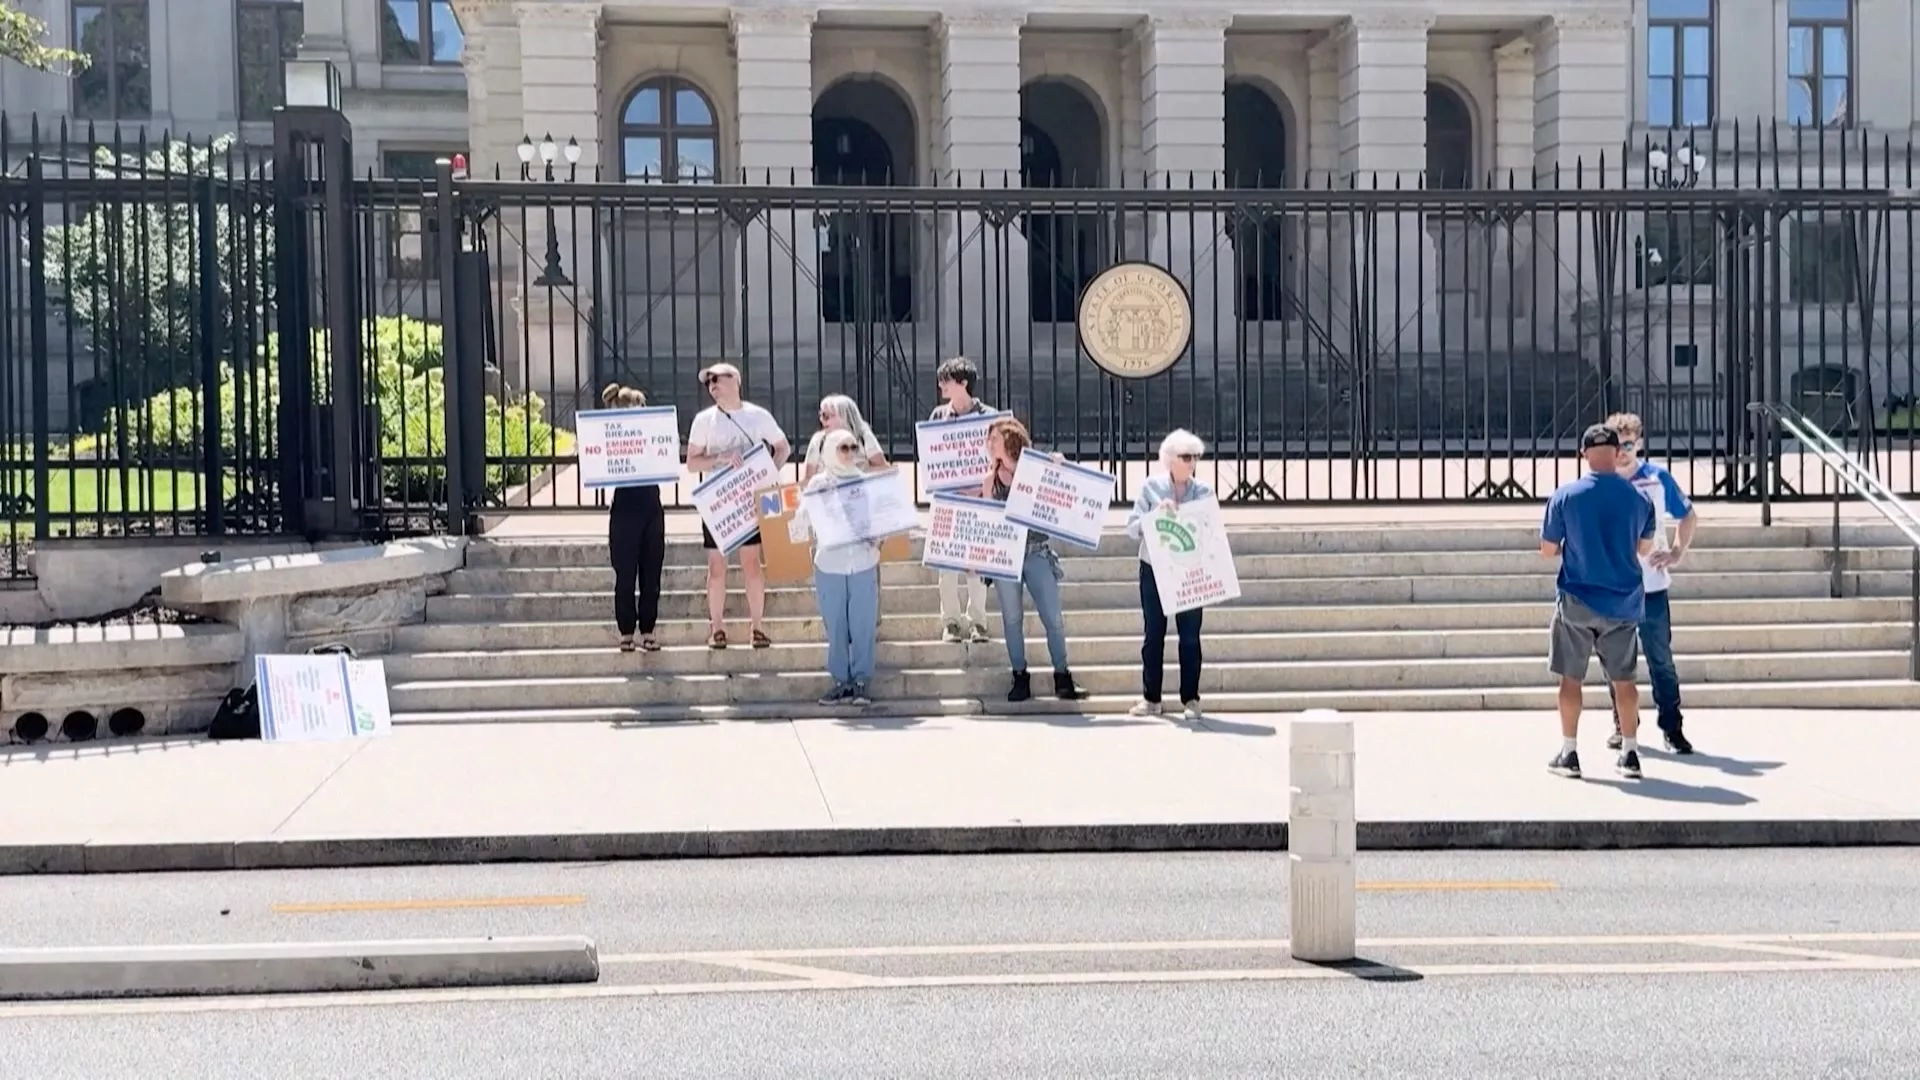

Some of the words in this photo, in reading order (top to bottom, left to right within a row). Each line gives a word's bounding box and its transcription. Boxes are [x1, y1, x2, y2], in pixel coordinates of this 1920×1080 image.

[604, 422, 622, 431] TAX
[605, 429, 643, 439] BREAKS
[585, 445, 602, 456] NO
[606, 438, 648, 449] EMINENT
[651, 435, 672, 445] FOR
[606, 447, 644, 457] DOMAIN
[657, 447, 668, 457] AI
[930, 442, 966, 454] NEVER
[957, 449, 979, 458] FOR
[607, 458, 631, 467] RATE
[608, 465, 637, 475] HIKES
[930, 469, 958, 480] DATA
[1043, 467, 1061, 478] TAX
[709, 489, 739, 513] NEVER
[740, 468, 768, 491] VOTED
[715, 467, 755, 498] GEORGIA
[1040, 476, 1078, 493] BREAKS
[734, 491, 753, 506] FOR
[1016, 483, 1033, 494] NO
[1037, 485, 1079, 504] EMINENT
[1082, 496, 1103, 510] FOR
[935, 507, 954, 515] OUR
[956, 510, 978, 520] DATA
[1033, 502, 1057, 515] RATE
[1036, 493, 1074, 509] DOMAIN
[1083, 511, 1095, 521] AI
[714, 499, 756, 532] HYPERSC
[934, 514, 953, 522] OUR
[955, 518, 972, 526] TAX
[974, 520, 1014, 532] DOLLARS
[1031, 510, 1060, 525] HIKES
[720, 520, 742, 539] DATA
[932, 529, 951, 538] OUR
[953, 532, 996, 545] UTILITIES
[933, 522, 952, 530] OUR
[954, 525, 985, 537] SEIZED
[987, 529, 1018, 541] HOMES
[930, 540, 945, 549] ALL
[948, 543, 967, 551] FOR
[969, 546, 996, 556] THEIR
[997, 549, 1007, 557] AI
[930, 547, 941, 555] TO
[944, 550, 965, 559] TAKE
[968, 554, 988, 562] OUR
[989, 557, 1013, 566] JOBS
[1176, 585, 1192, 598] TAX
[1194, 579, 1224, 596] BREAKS
